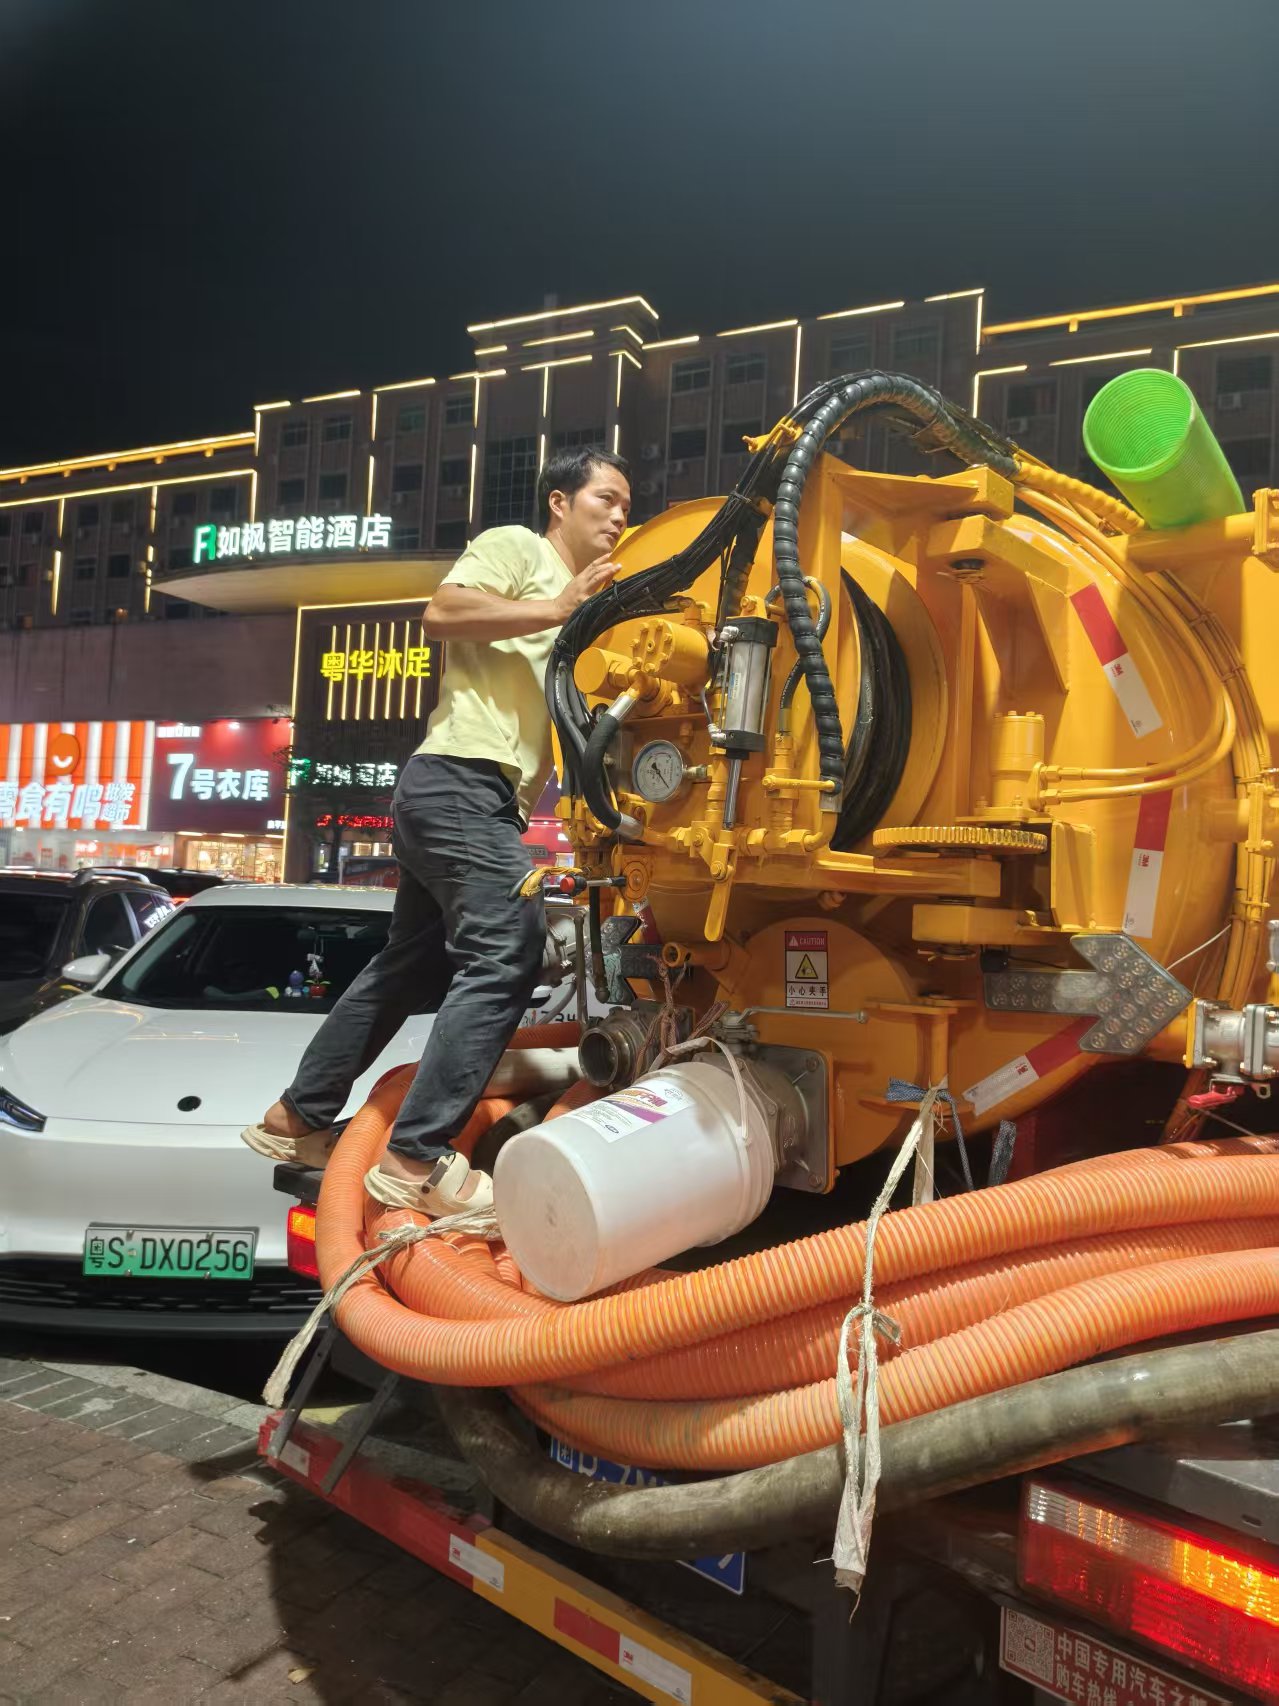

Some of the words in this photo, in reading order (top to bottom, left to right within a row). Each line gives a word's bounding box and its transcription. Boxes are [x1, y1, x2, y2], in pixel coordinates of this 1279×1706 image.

[216, 513, 392, 559] 如枫智能酒店
[320, 646, 430, 682] 粤华沐足
[167, 753, 269, 801] 7号衣库
[799, 937, 825, 945] CAUTION
